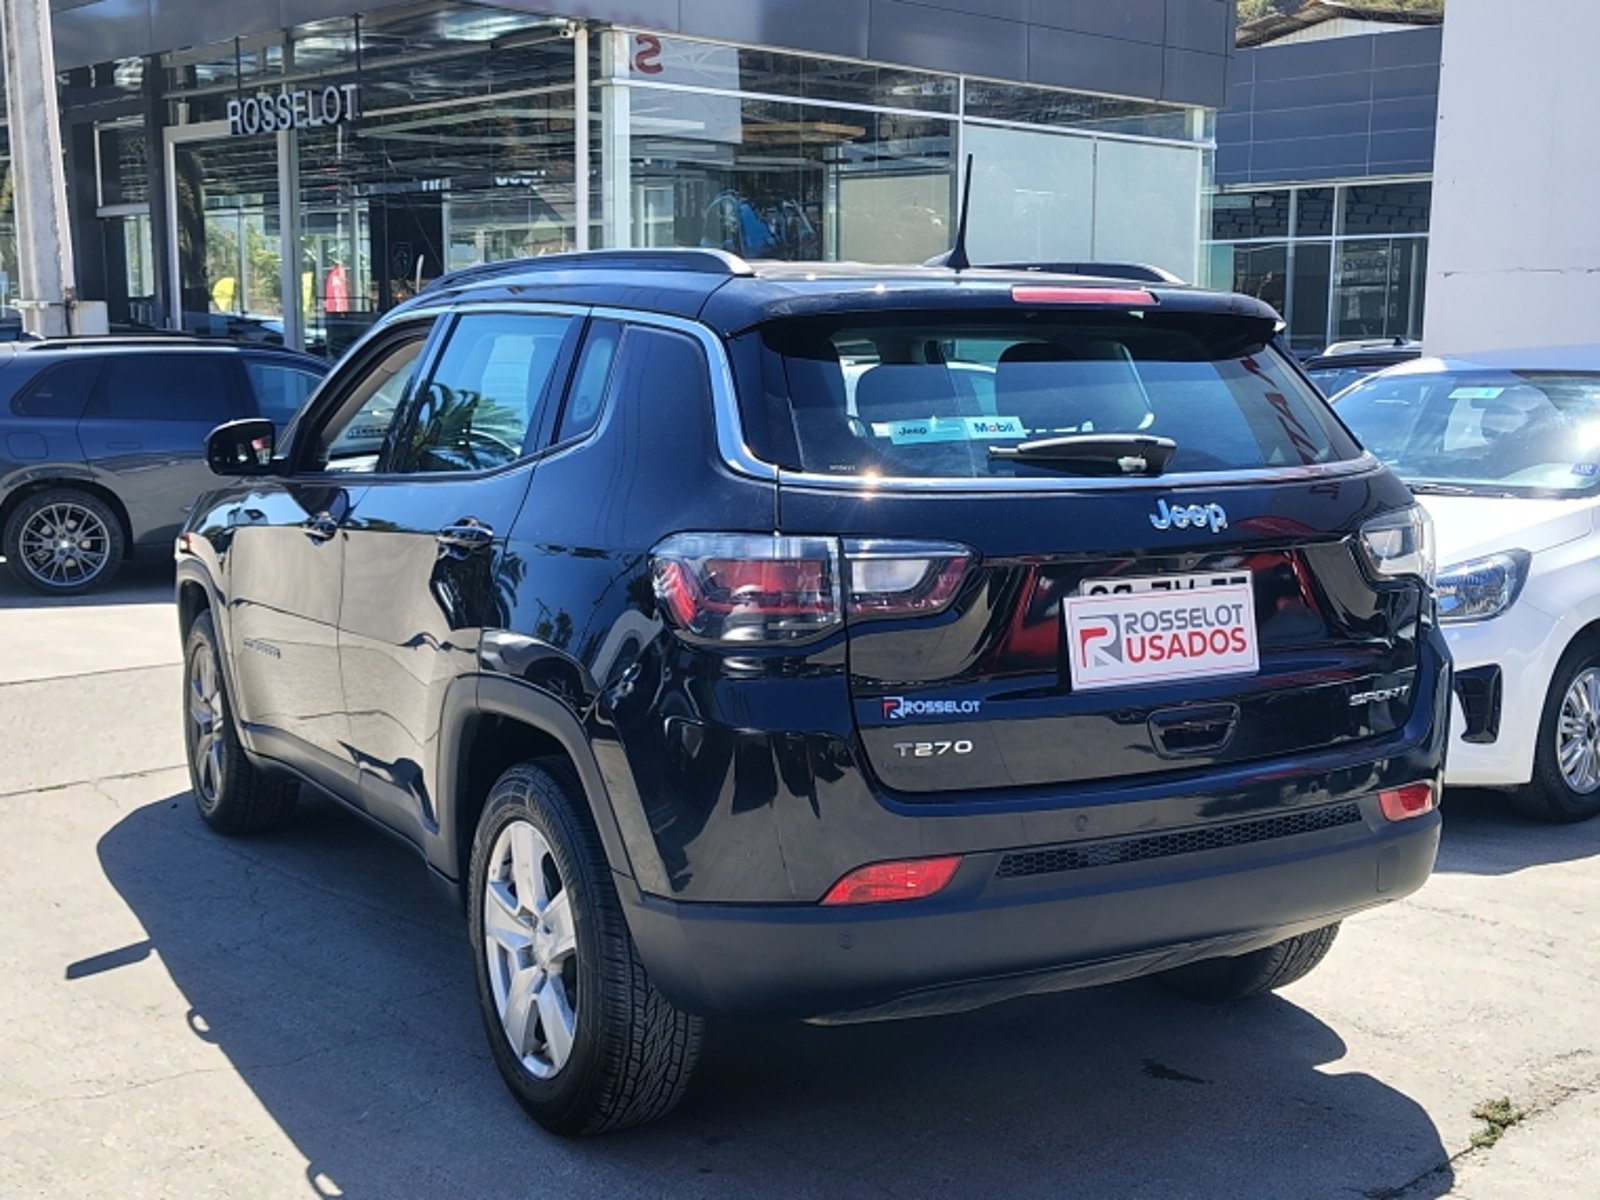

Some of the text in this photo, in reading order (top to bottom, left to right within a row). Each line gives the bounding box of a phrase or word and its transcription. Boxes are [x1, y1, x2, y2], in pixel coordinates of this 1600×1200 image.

[227, 83, 357, 135] ROSSELOT
[1148, 499, 1229, 534] Jeep
[1124, 603, 1243, 635] ROSSELOT
[1126, 627, 1247, 664] USADOS
[904, 700, 981, 715] ROSSELOT
[1348, 684, 1410, 706] SPORT
[892, 740, 974, 757] T270
